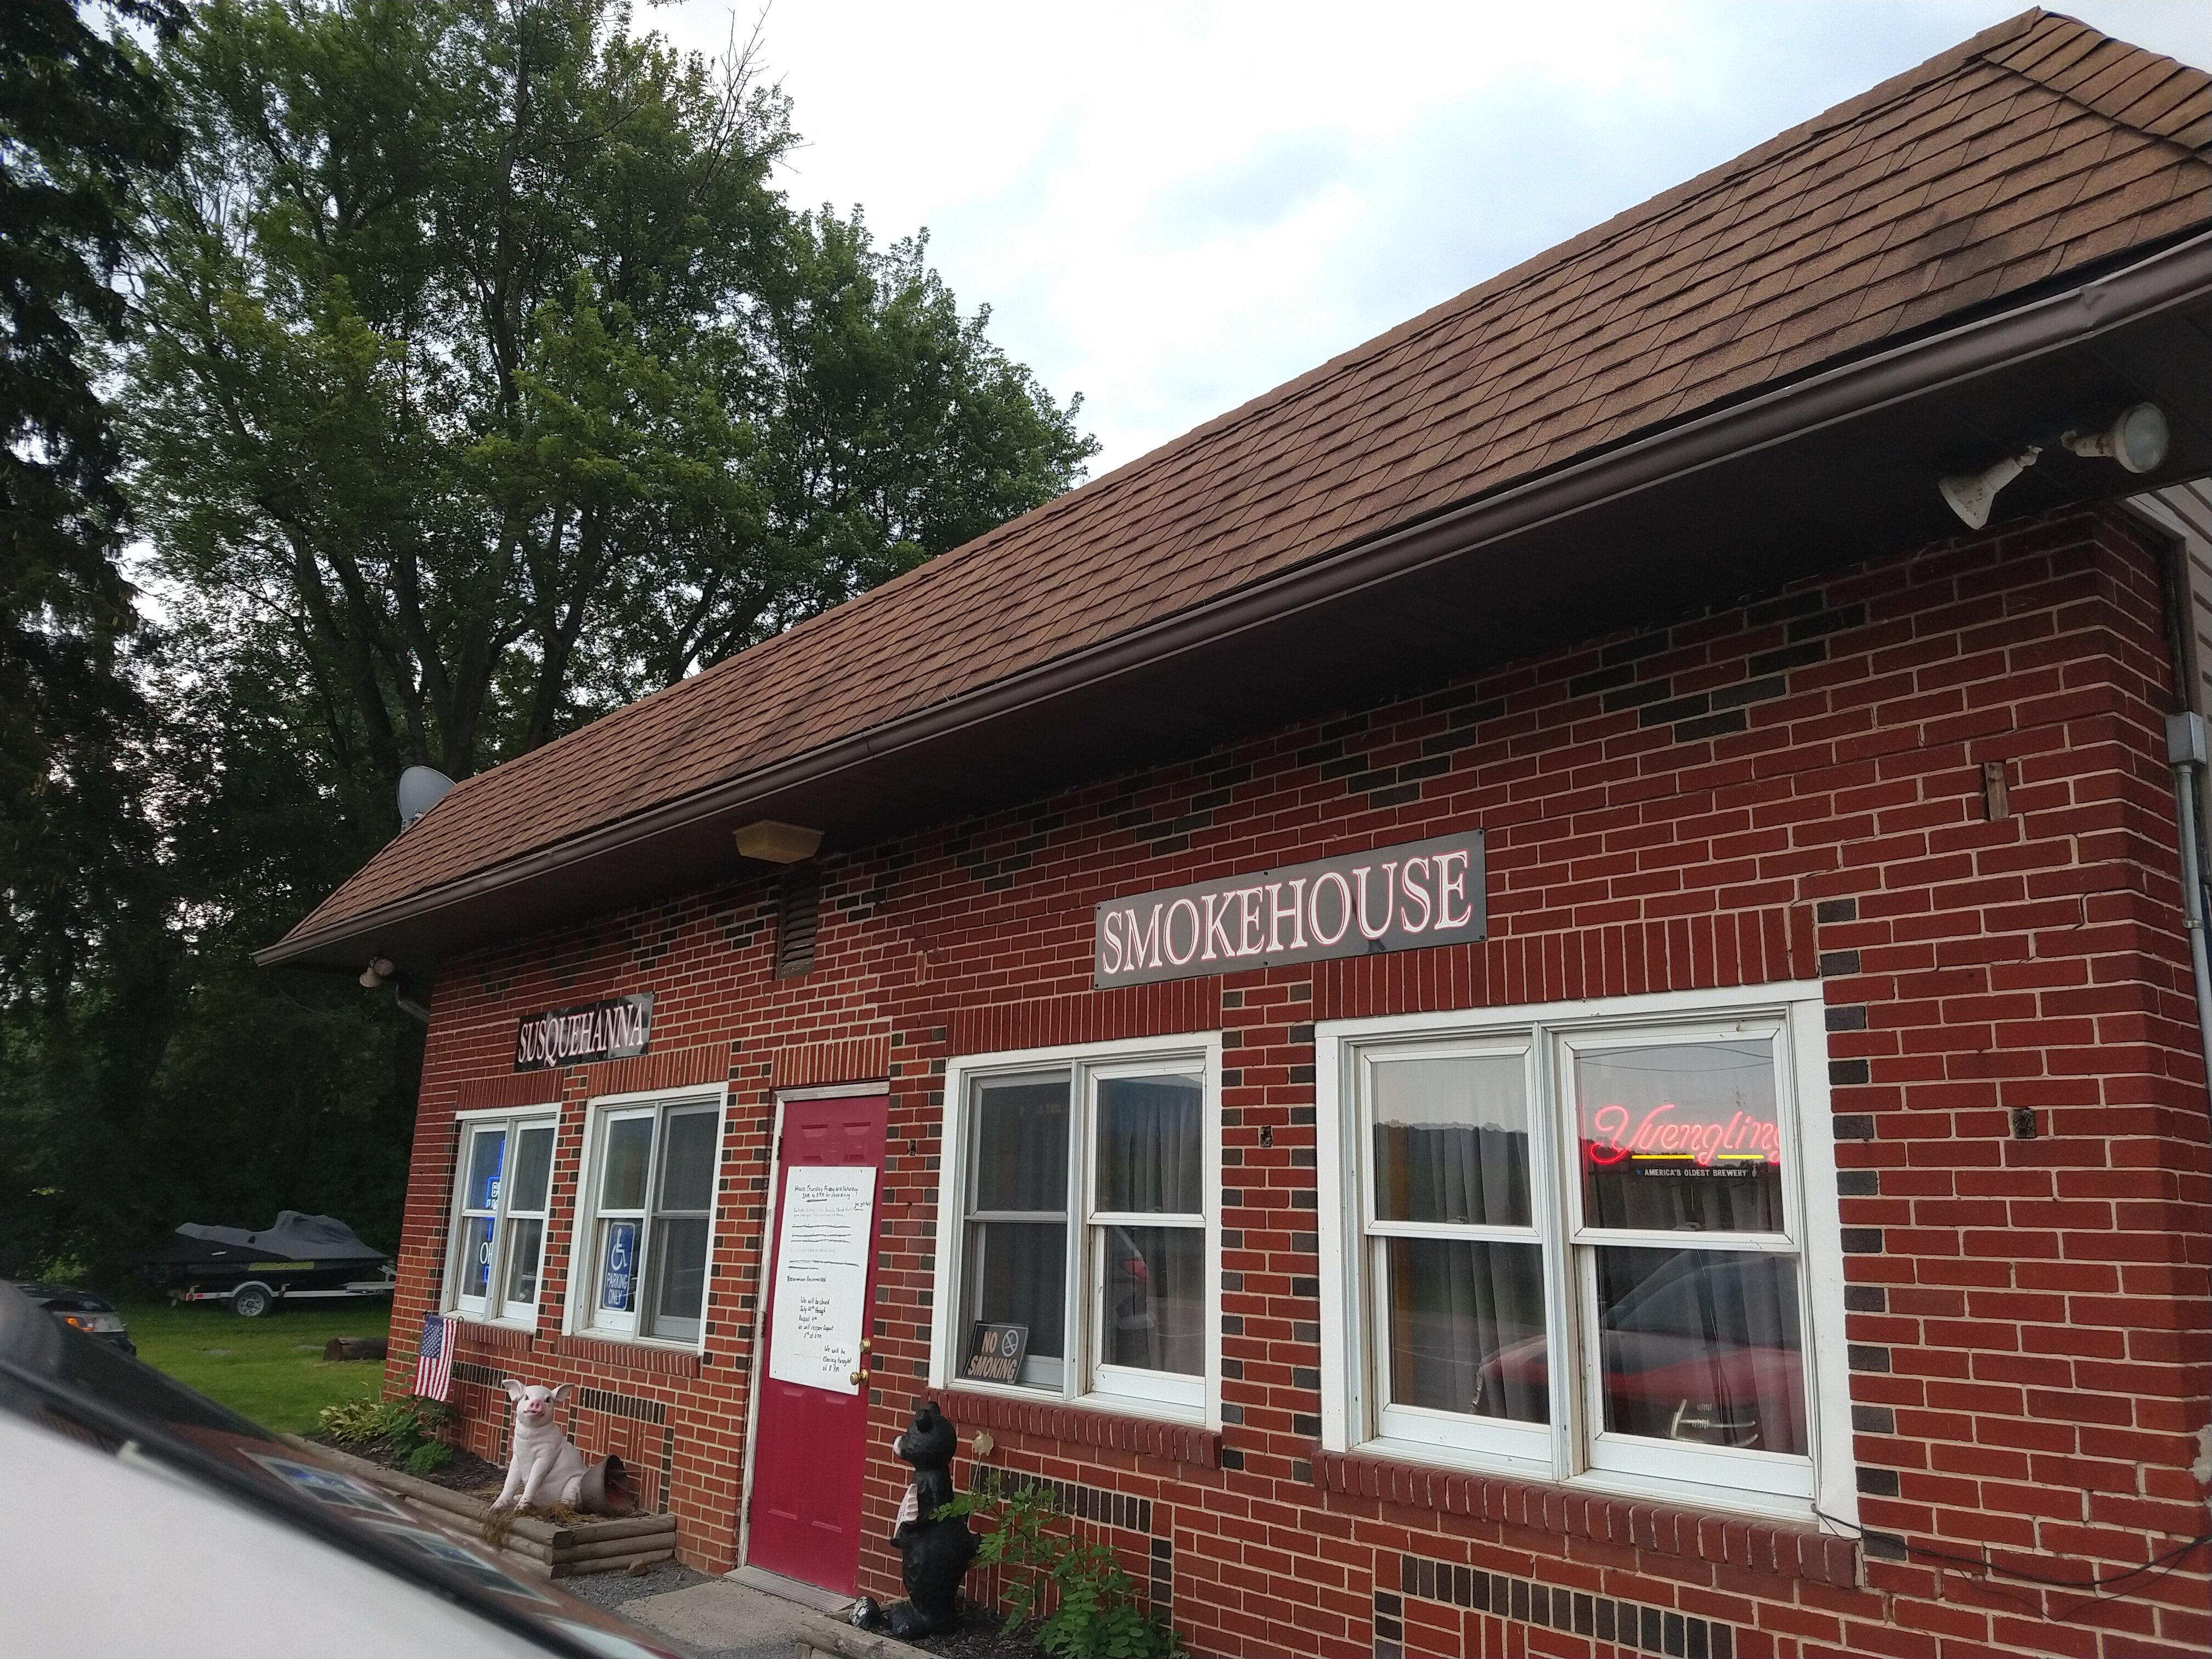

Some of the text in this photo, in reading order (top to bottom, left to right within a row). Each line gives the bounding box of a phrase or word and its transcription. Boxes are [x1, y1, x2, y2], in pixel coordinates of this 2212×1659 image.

[1102, 849, 1473, 975] SMOKEHOUSE
[518, 1002, 644, 1067] SUSQUEHANNA
[1644, 1169, 1747, 1177] AMERICA'S OLDEST BREWERY
[807, 1185, 822, 1193] Thursday
[824, 1186, 834, 1194] Friday
[843, 1185, 858, 1195] Saturday
[606, 1272, 628, 1289] PARKING
[608, 1290, 623, 1305] ONLY
[799, 1314, 810, 1324] August
[981, 1331, 998, 1353] NO
[967, 1355, 1018, 1380] SMOKING
